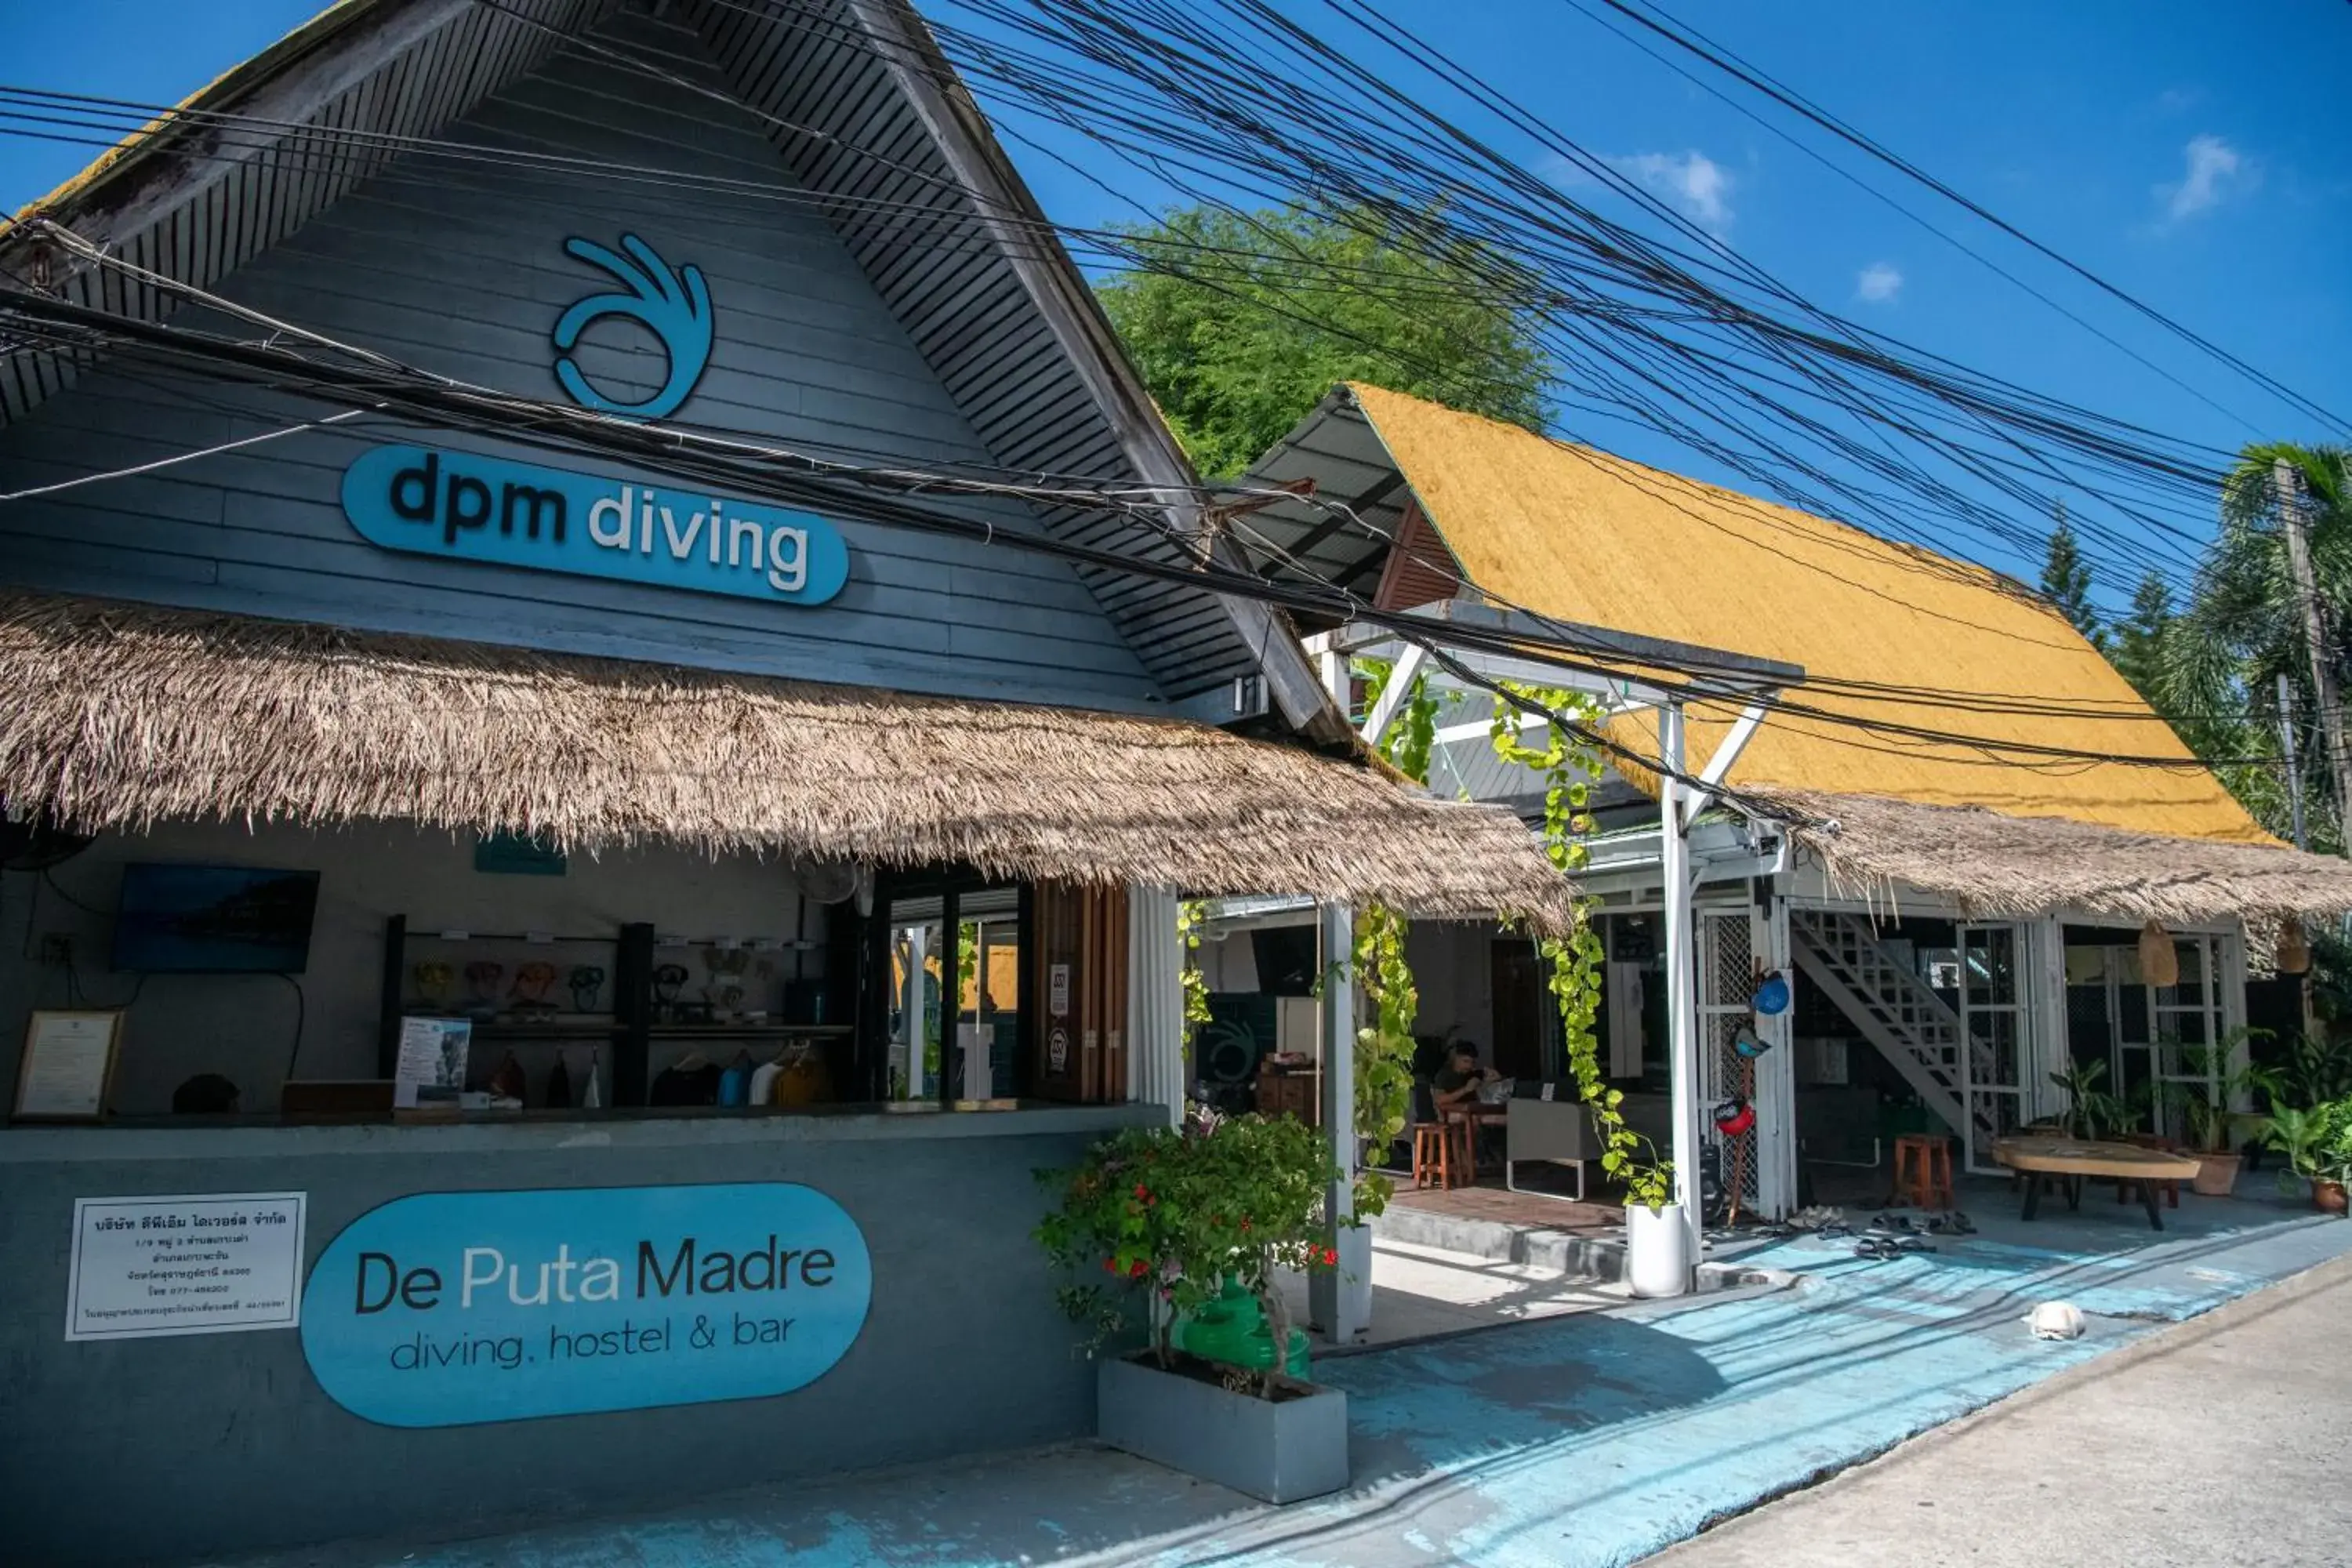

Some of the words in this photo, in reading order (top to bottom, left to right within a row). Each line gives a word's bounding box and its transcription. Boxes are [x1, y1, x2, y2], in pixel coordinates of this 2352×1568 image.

[390, 453, 567, 544] dpm
[589, 485, 808, 593] diving
[355, 1252, 442, 1315] De
[461, 1243, 620, 1308] Puta
[636, 1234, 836, 1298] Madre
[549, 1317, 671, 1360] hostel
[689, 1315, 716, 1350] &
[733, 1312, 797, 1346] bar
